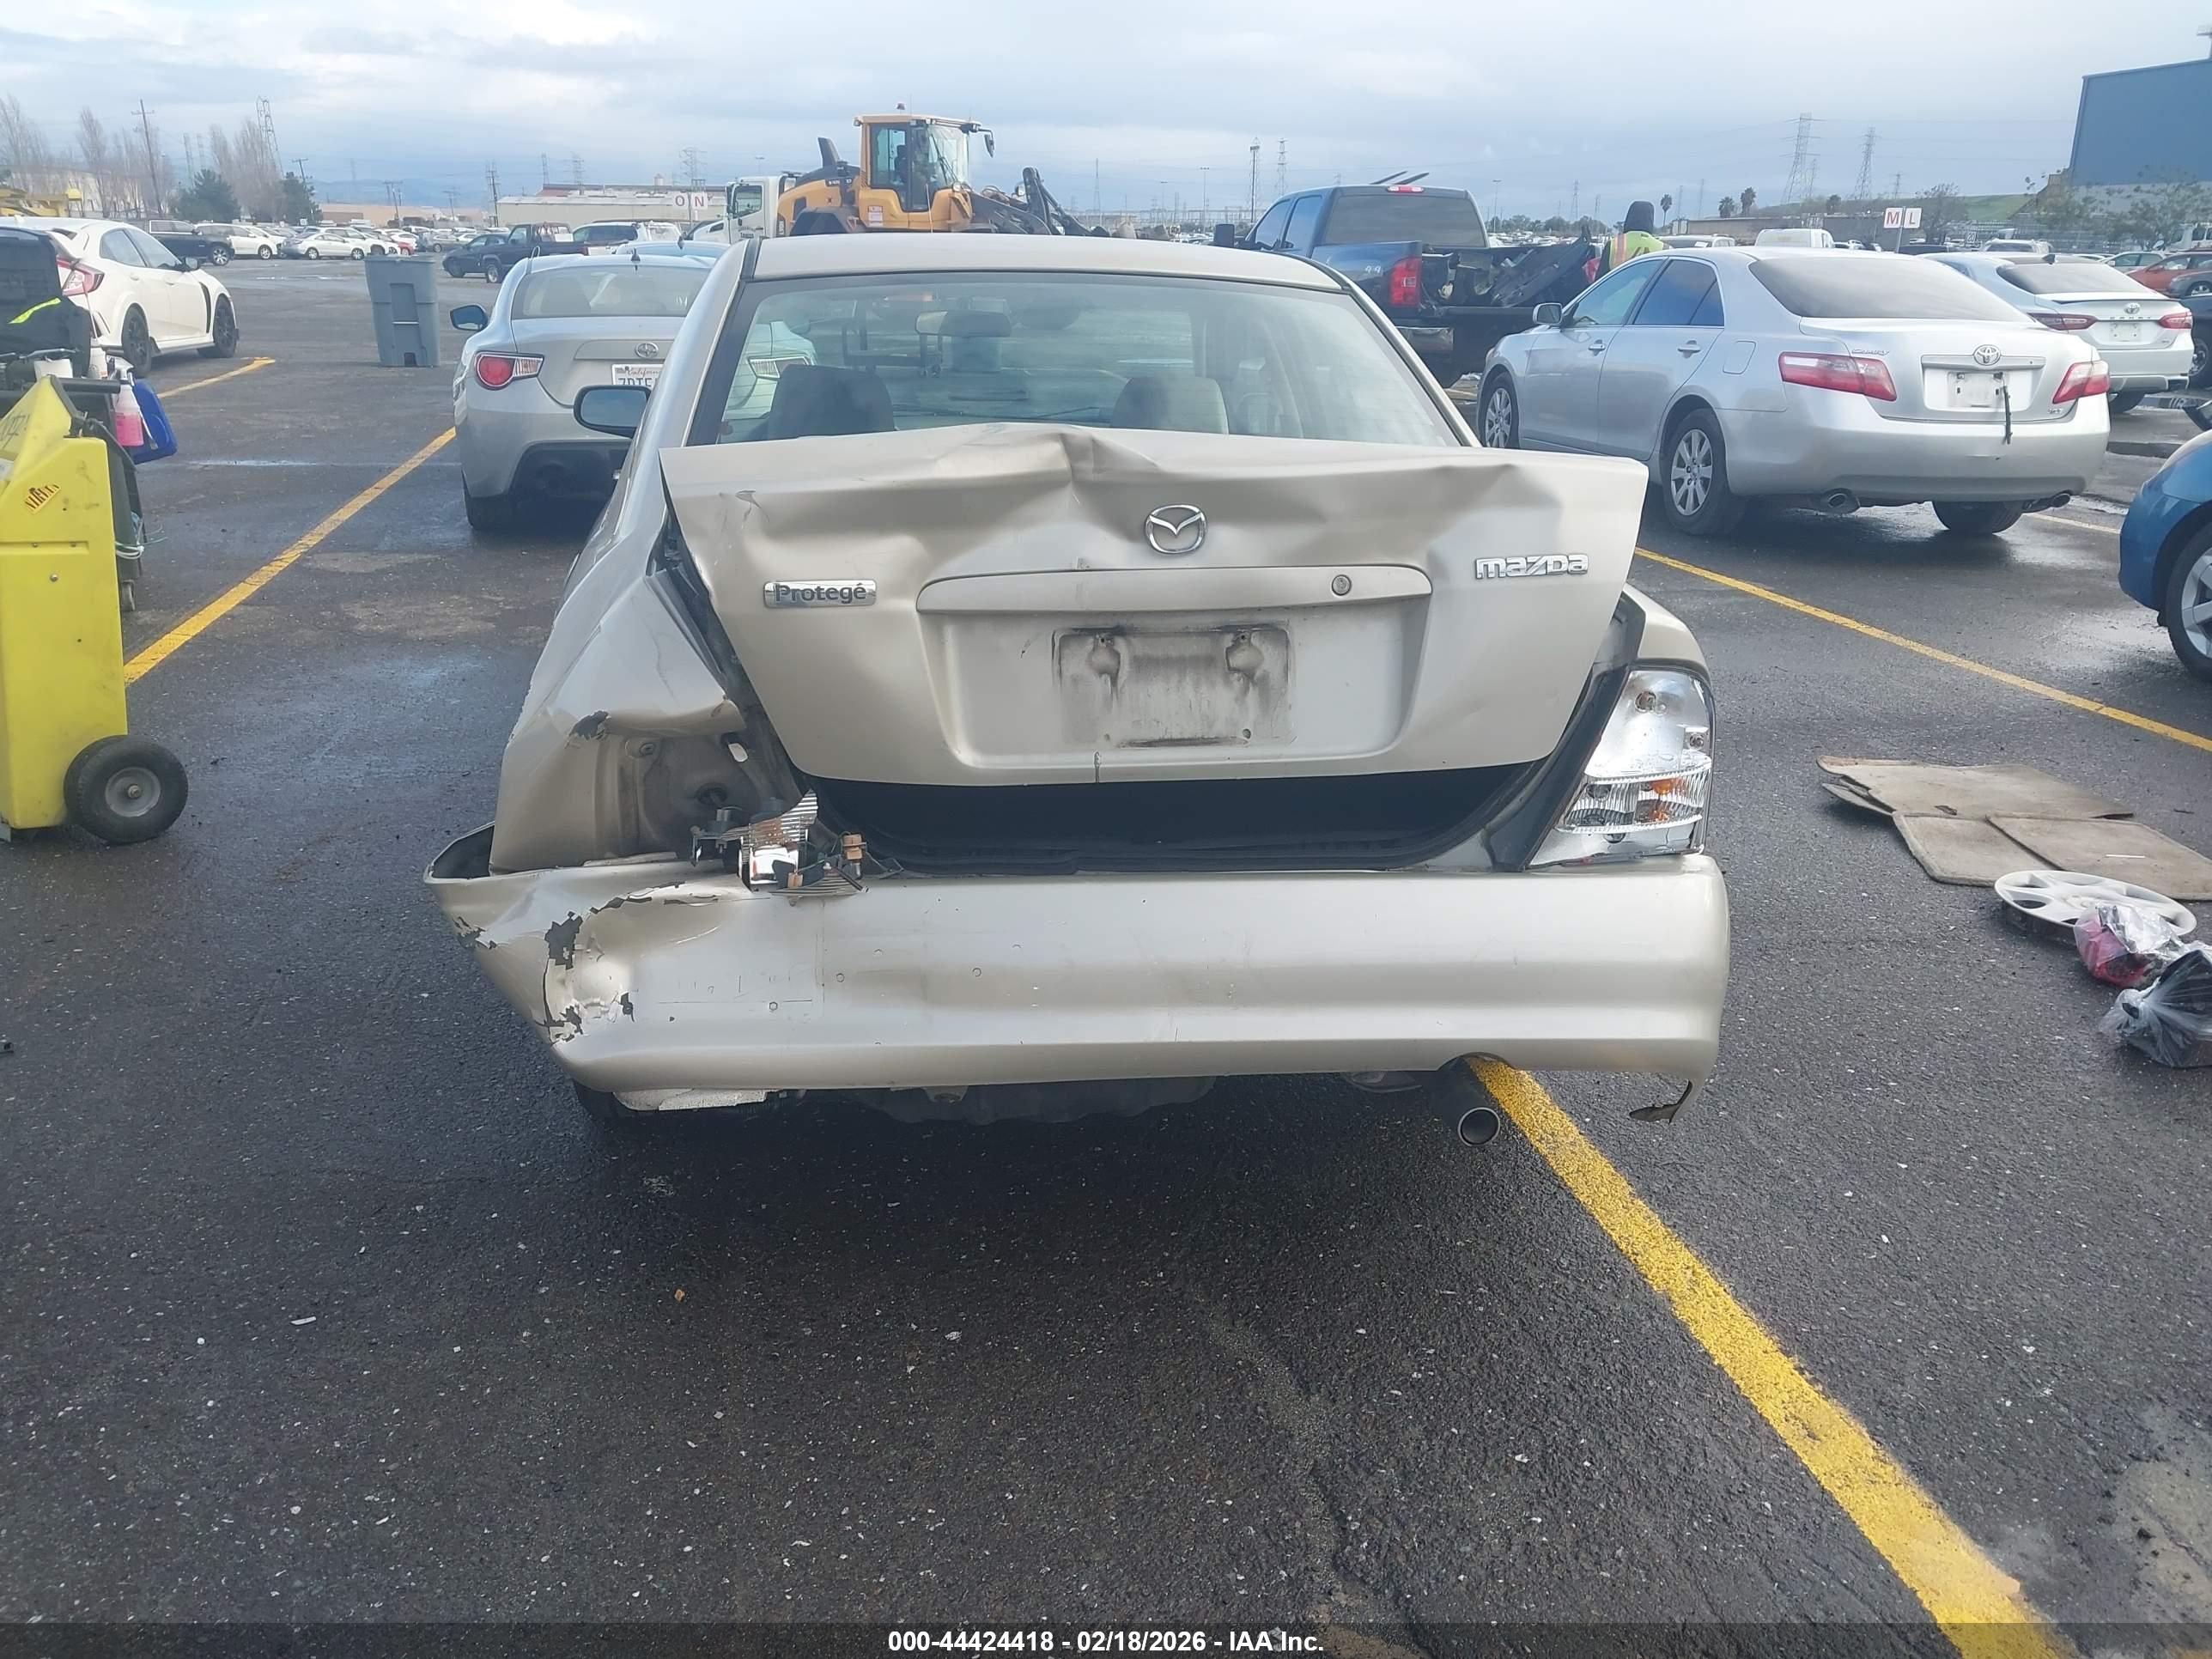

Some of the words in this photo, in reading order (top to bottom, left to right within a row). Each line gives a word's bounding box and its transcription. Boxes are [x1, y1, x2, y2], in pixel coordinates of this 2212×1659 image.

[695, 196, 704, 207] N
[1886, 211, 1899, 225] M
[1909, 212, 1917, 225] L
[775, 582, 866, 605] Protegé
